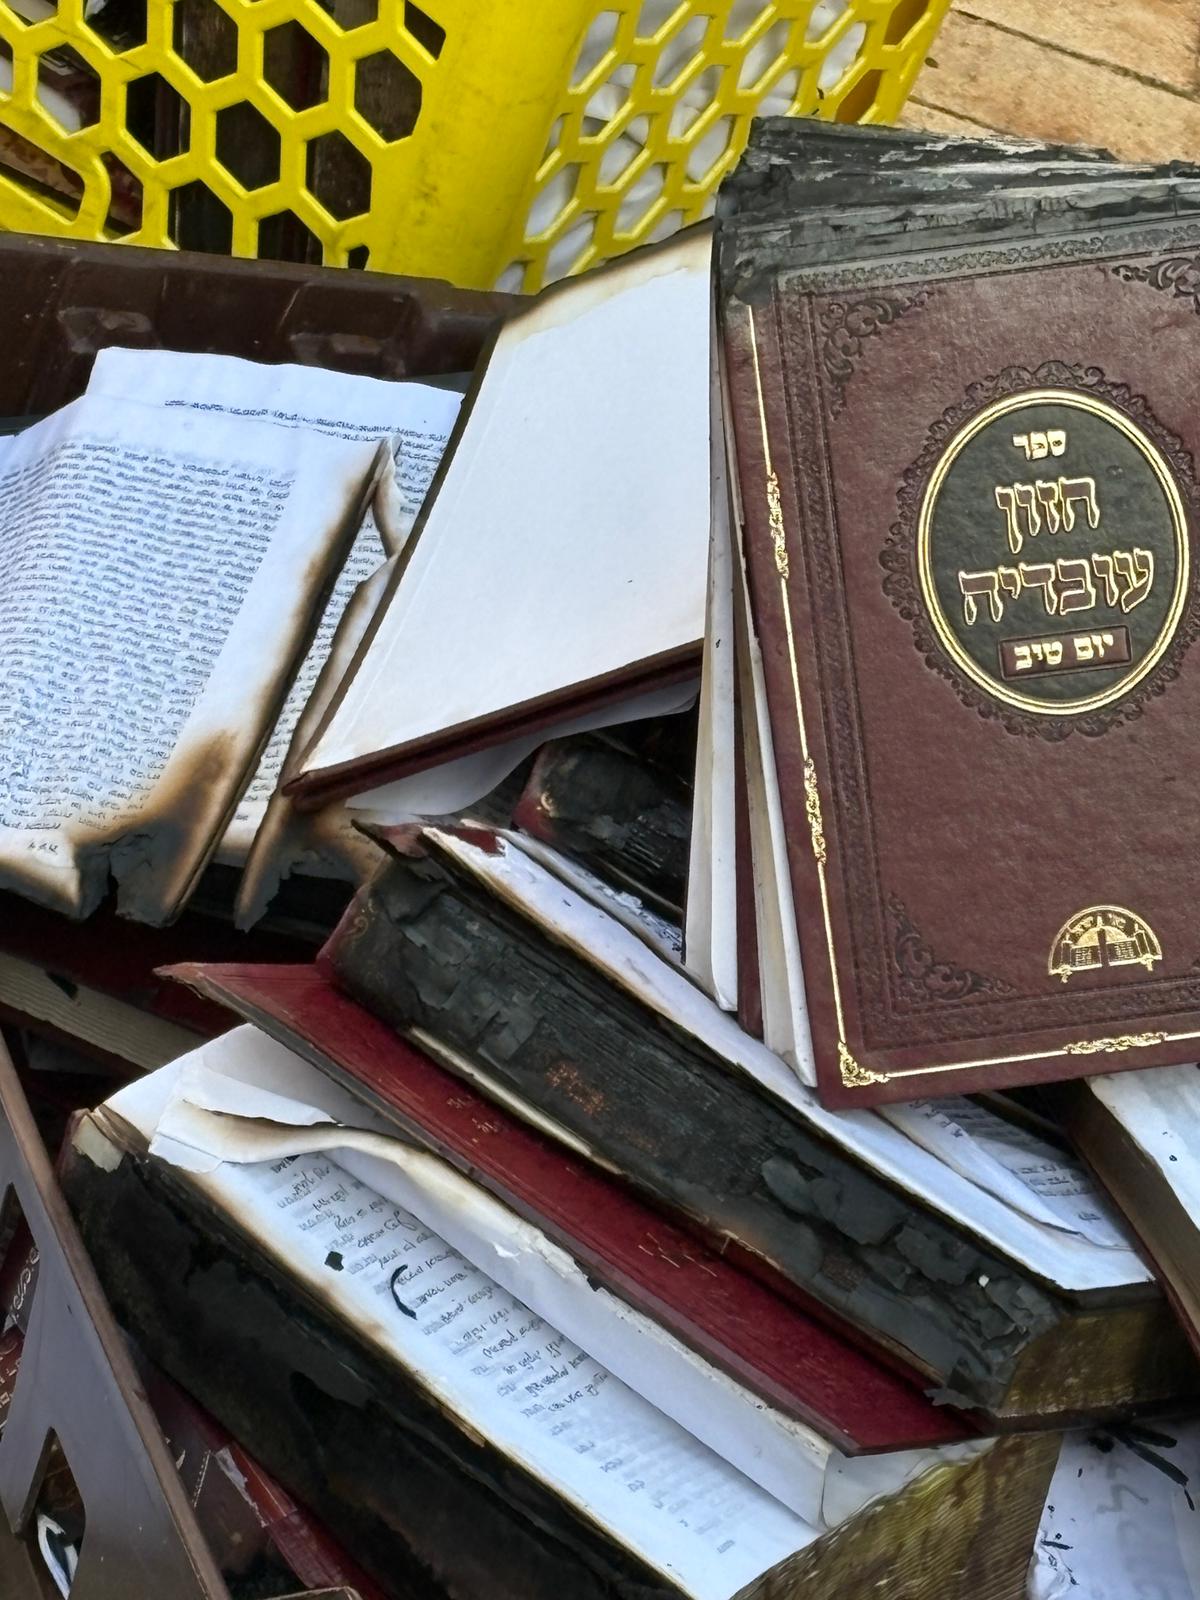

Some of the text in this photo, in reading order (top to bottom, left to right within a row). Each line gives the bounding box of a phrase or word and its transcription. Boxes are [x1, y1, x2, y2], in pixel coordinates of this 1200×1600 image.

[1013, 430, 1066, 460] ספר
[995, 477, 1100, 554] חזון
[958, 547, 1154, 625] עובדיה
[1073, 633, 1113, 660] יום
